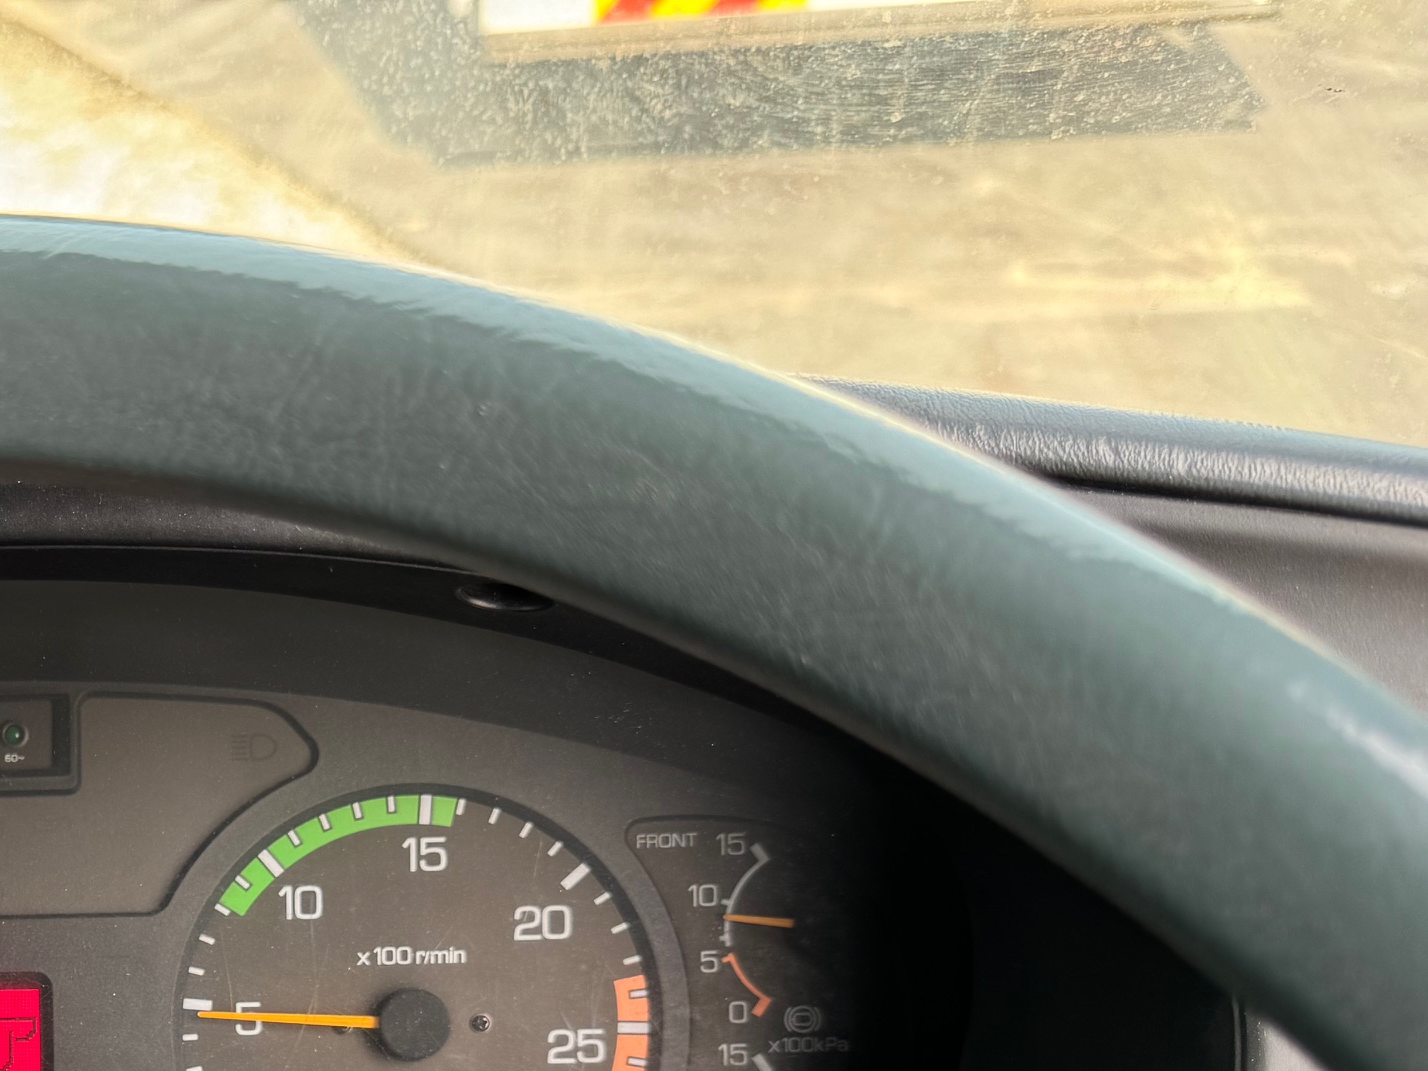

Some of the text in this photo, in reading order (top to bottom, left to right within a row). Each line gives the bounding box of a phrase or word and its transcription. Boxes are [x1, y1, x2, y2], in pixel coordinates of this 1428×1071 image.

[636, 833, 697, 849] FRONT
[716, 833, 747, 856] 15
[402, 837, 449, 873] 15
[278, 885, 324, 920] 10
[688, 885, 718, 907] 10
[514, 905, 573, 941] 20
[700, 951, 719, 973] 5
[235, 1002, 264, 1036] 5
[729, 1001, 748, 1025] 0
[547, 1030, 607, 1065] 25
[718, 1043, 749, 1066] 15
